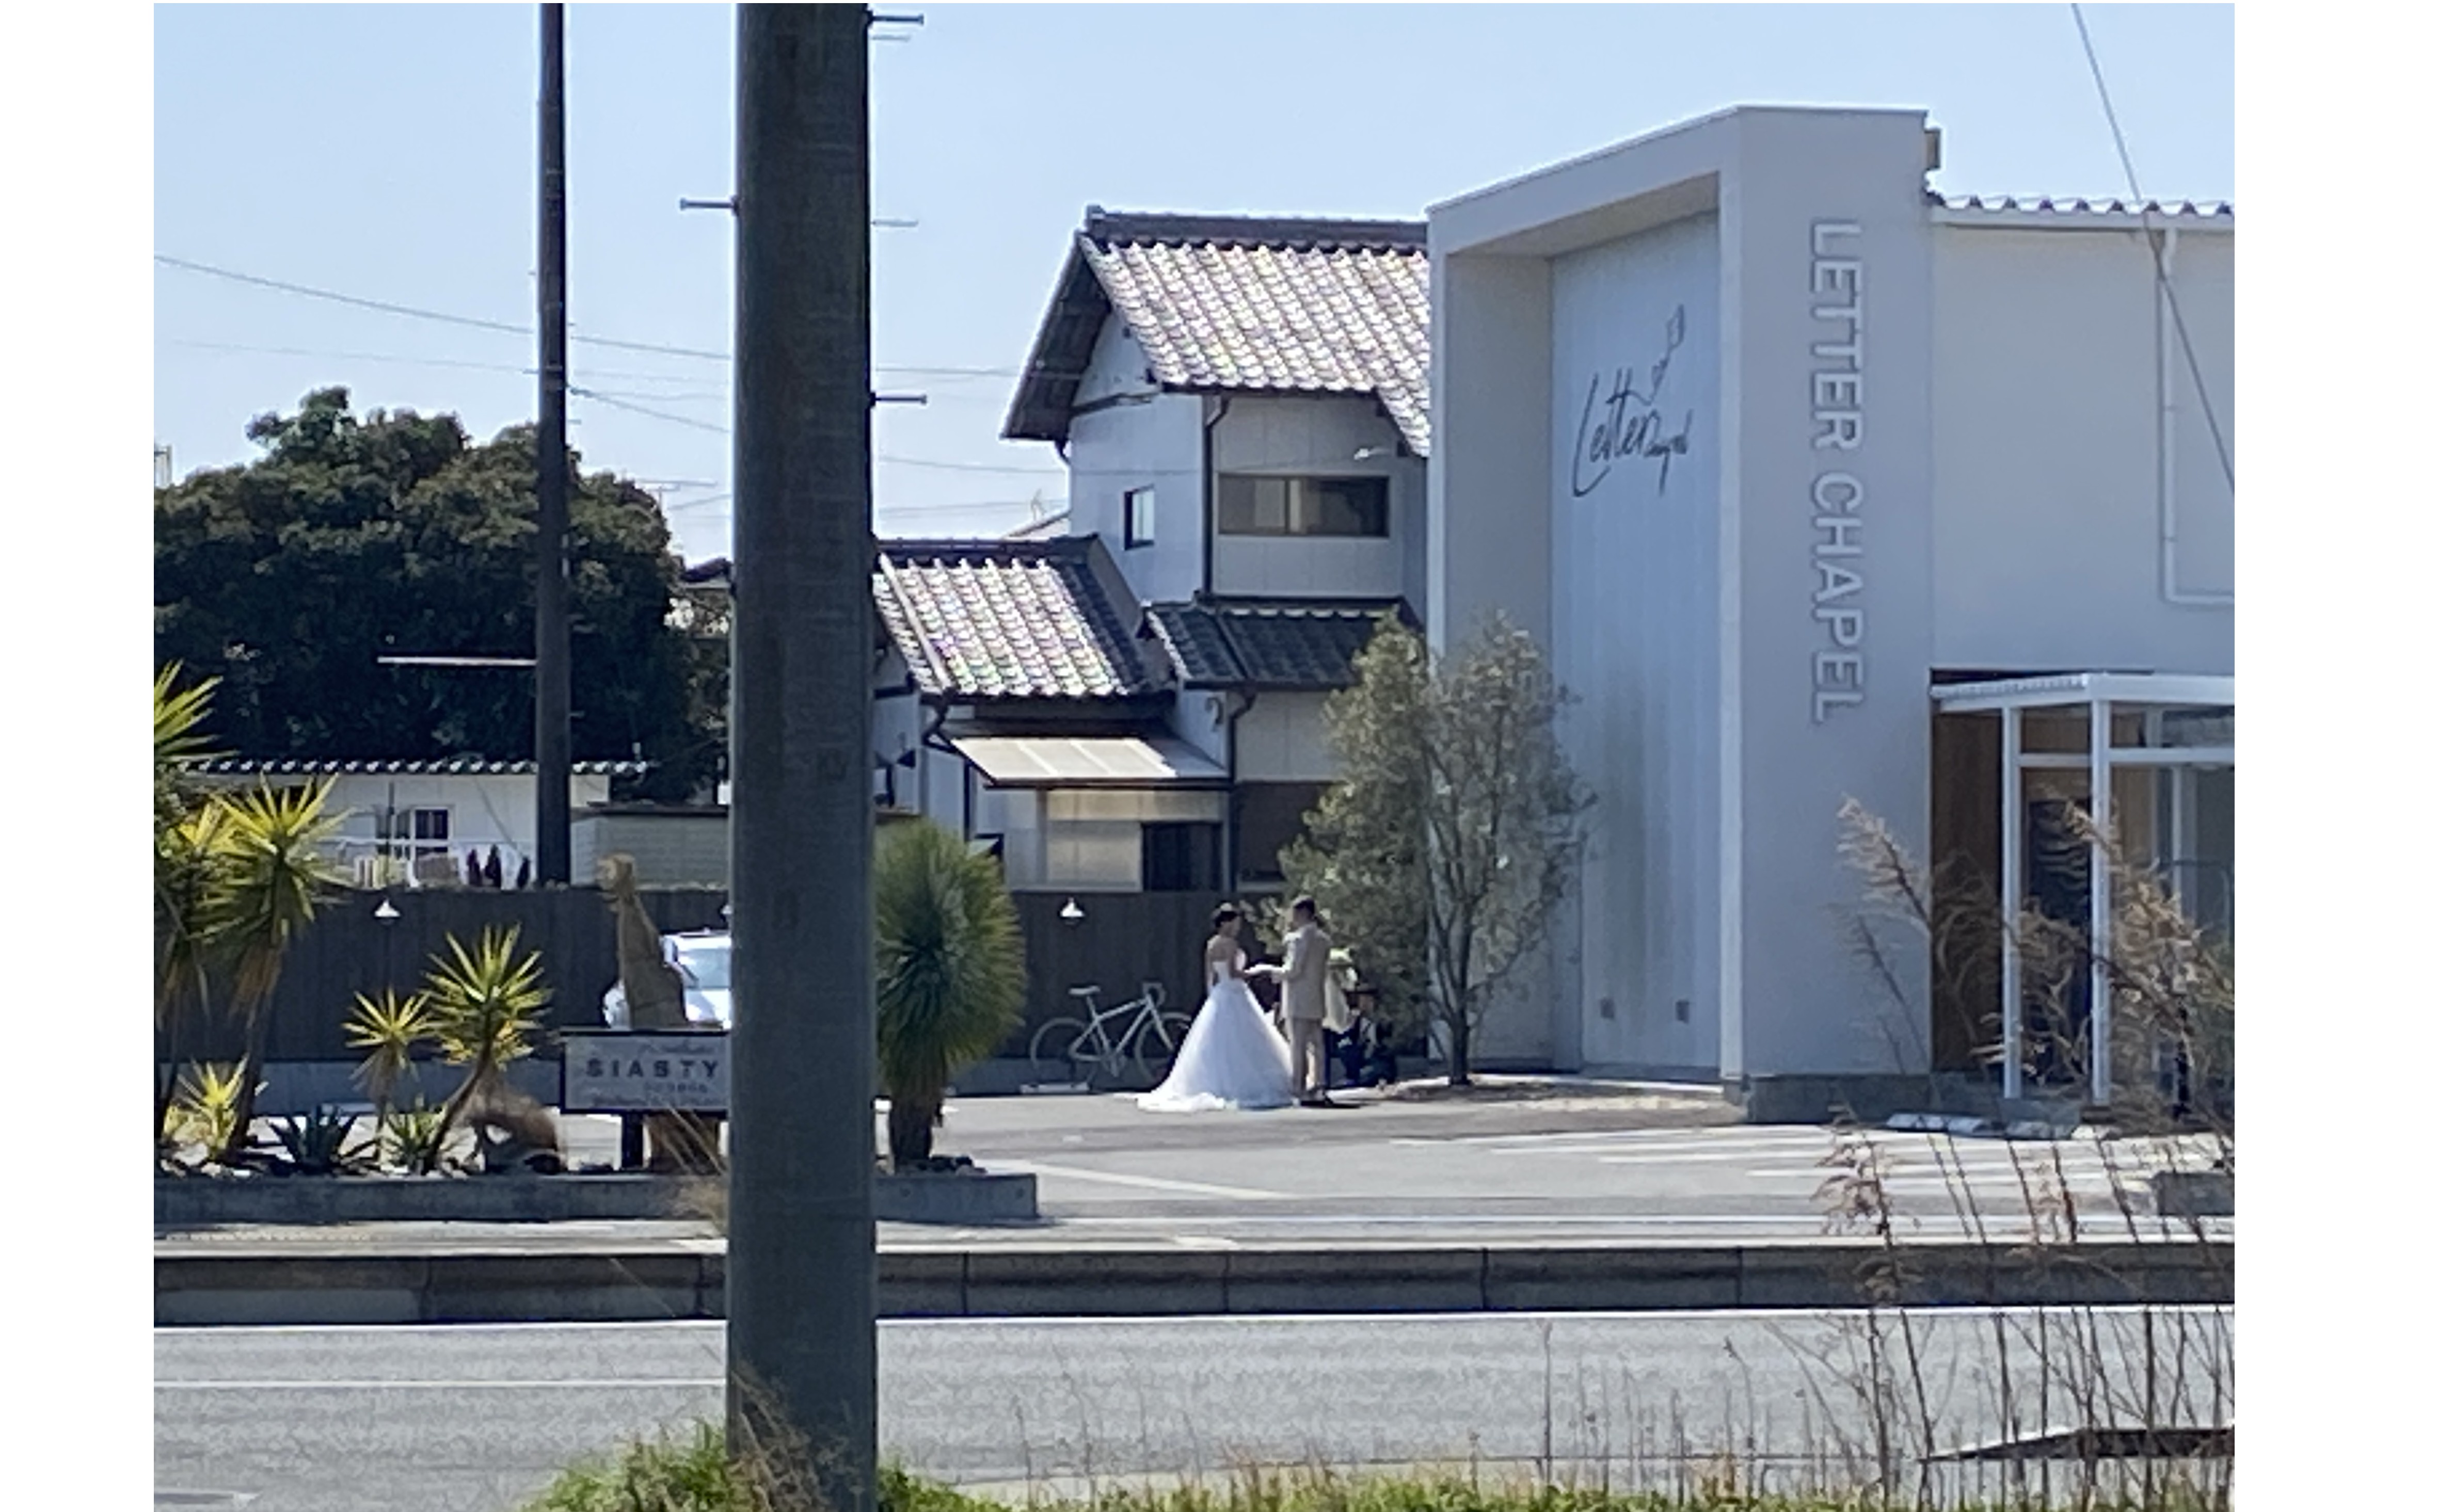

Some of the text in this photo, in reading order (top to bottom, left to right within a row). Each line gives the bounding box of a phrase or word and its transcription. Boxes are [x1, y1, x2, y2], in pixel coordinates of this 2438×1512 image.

[1572, 367, 1661, 496] Letter
[1811, 220, 1863, 723] LETTER CHAPEL
